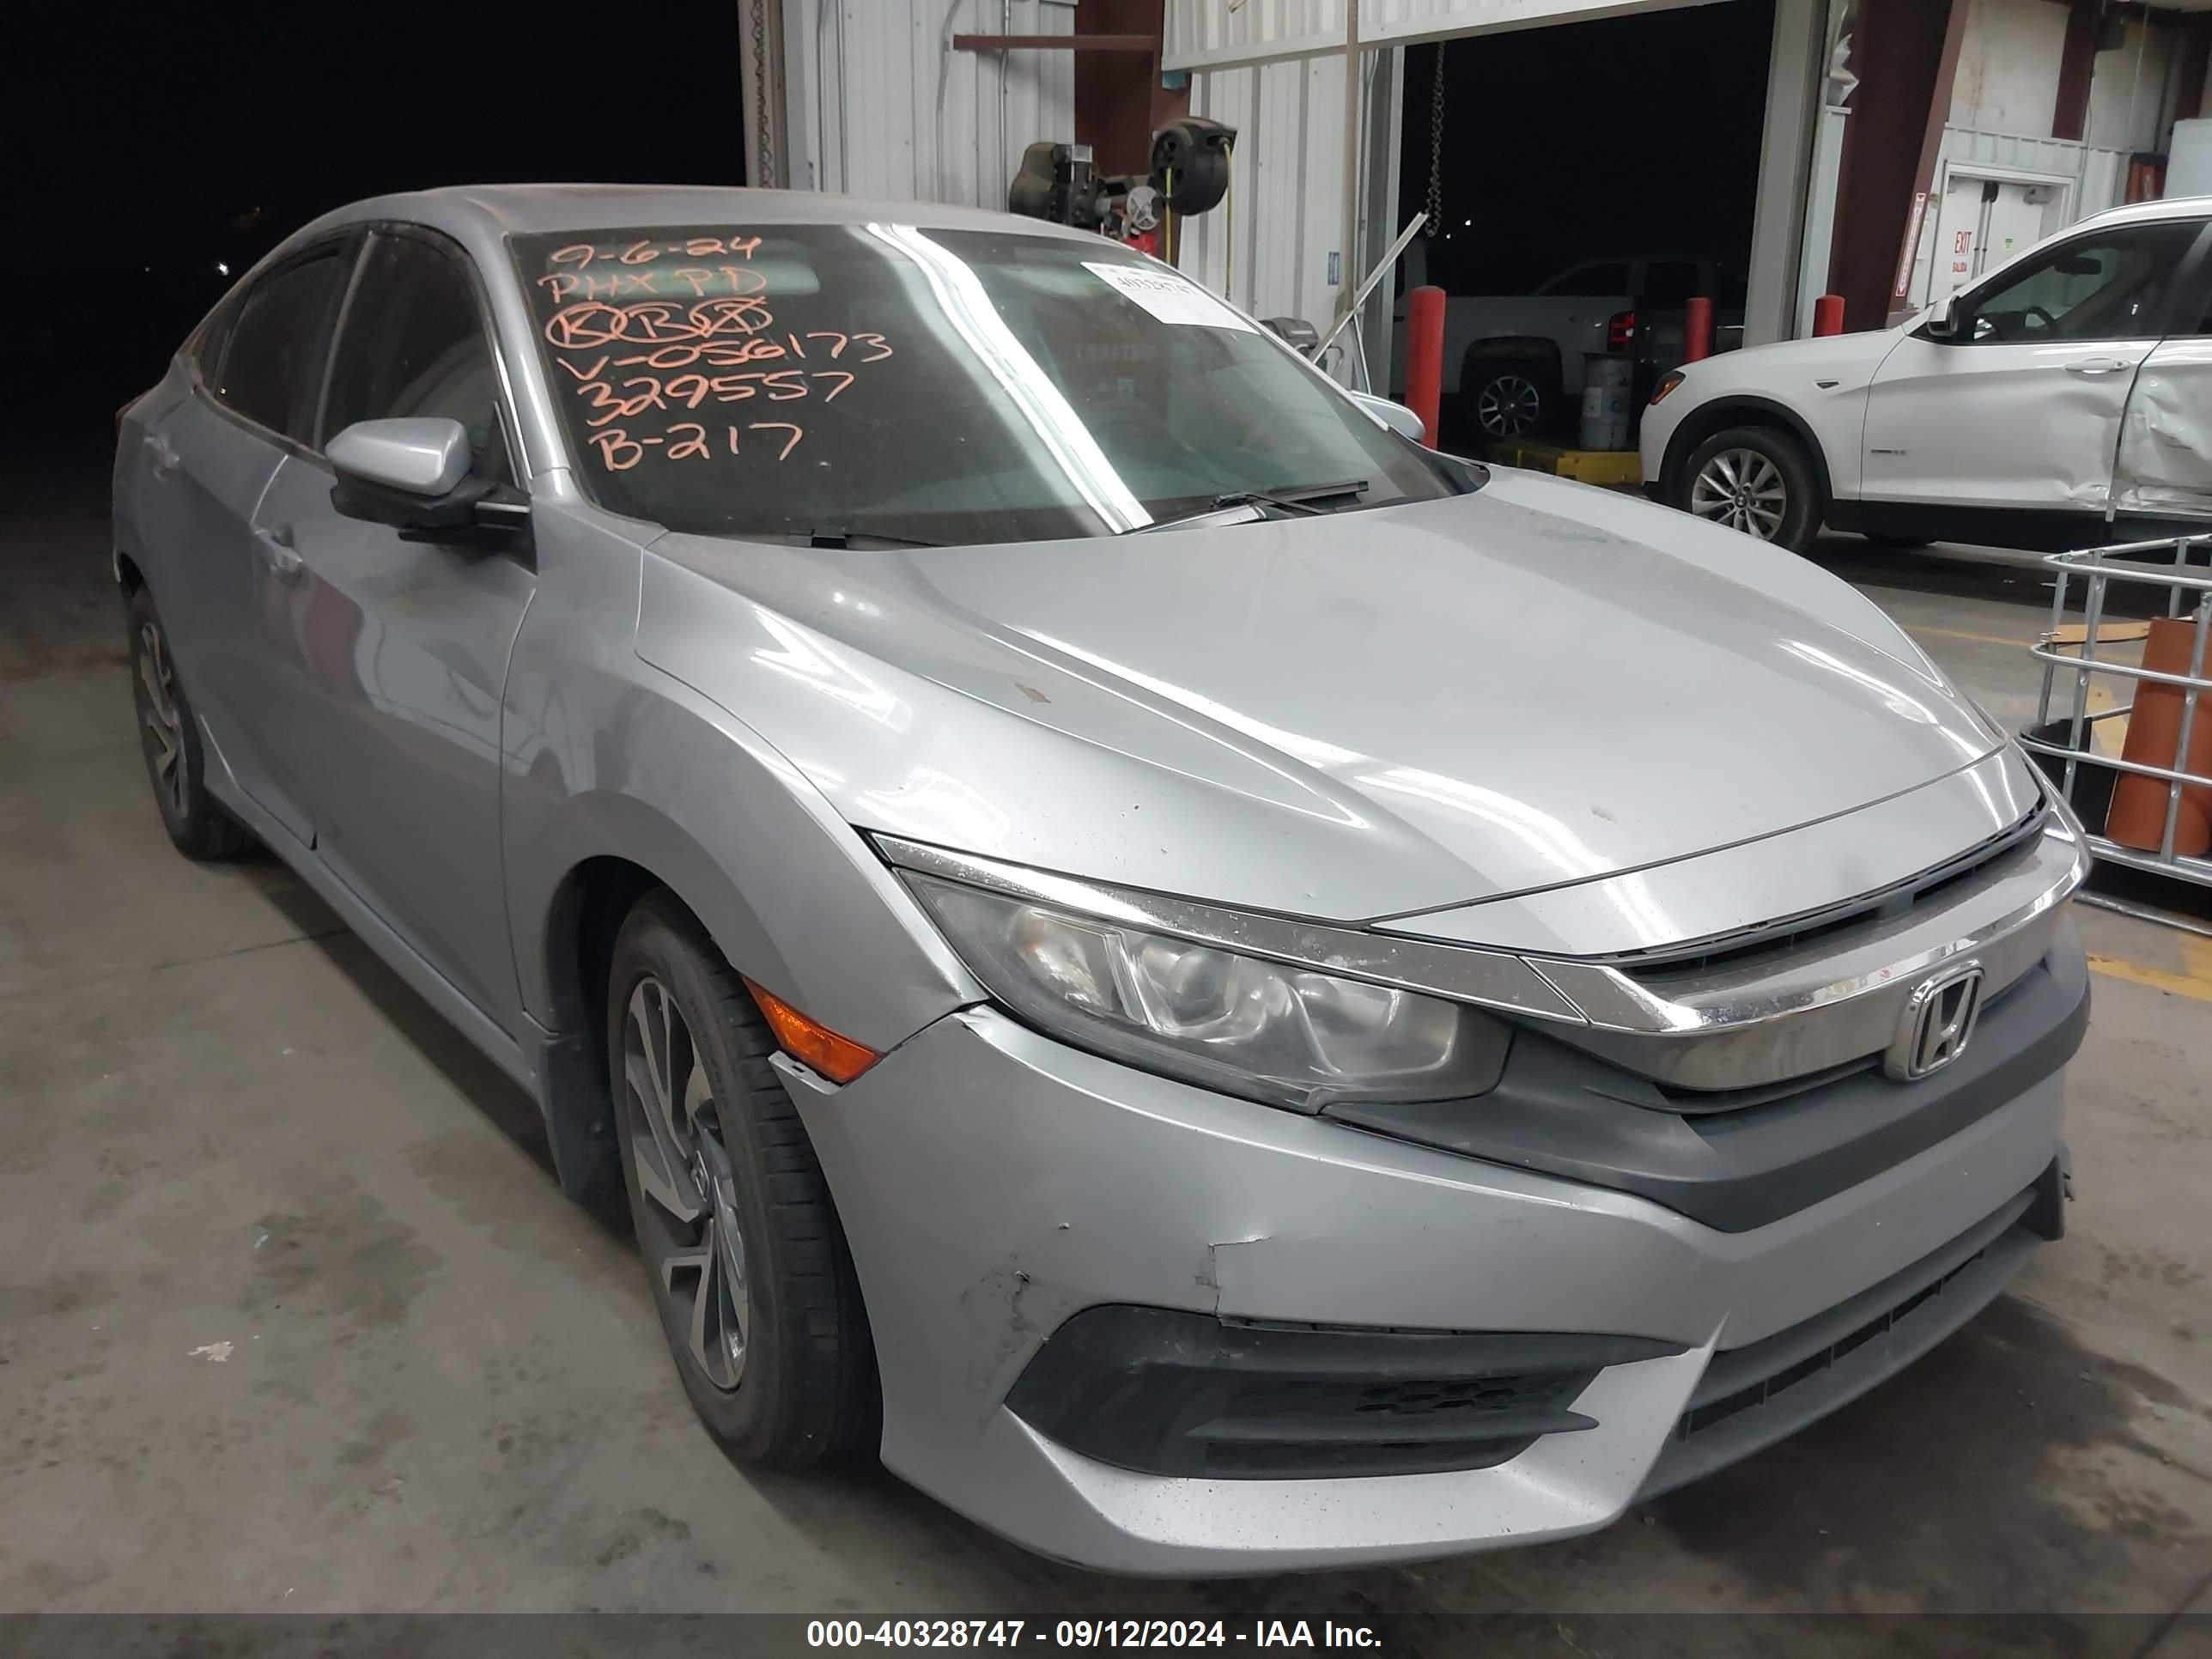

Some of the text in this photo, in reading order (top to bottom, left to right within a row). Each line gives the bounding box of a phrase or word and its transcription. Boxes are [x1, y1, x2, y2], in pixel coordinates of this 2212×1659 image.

[551, 236, 763, 269] 9-6-24
[1955, 231, 1972, 253] EXIT
[538, 267, 767, 303] PHX PD
[556, 331, 894, 380] V-056173
[577, 370, 855, 427] 329557
[588, 423, 803, 471] B-217
